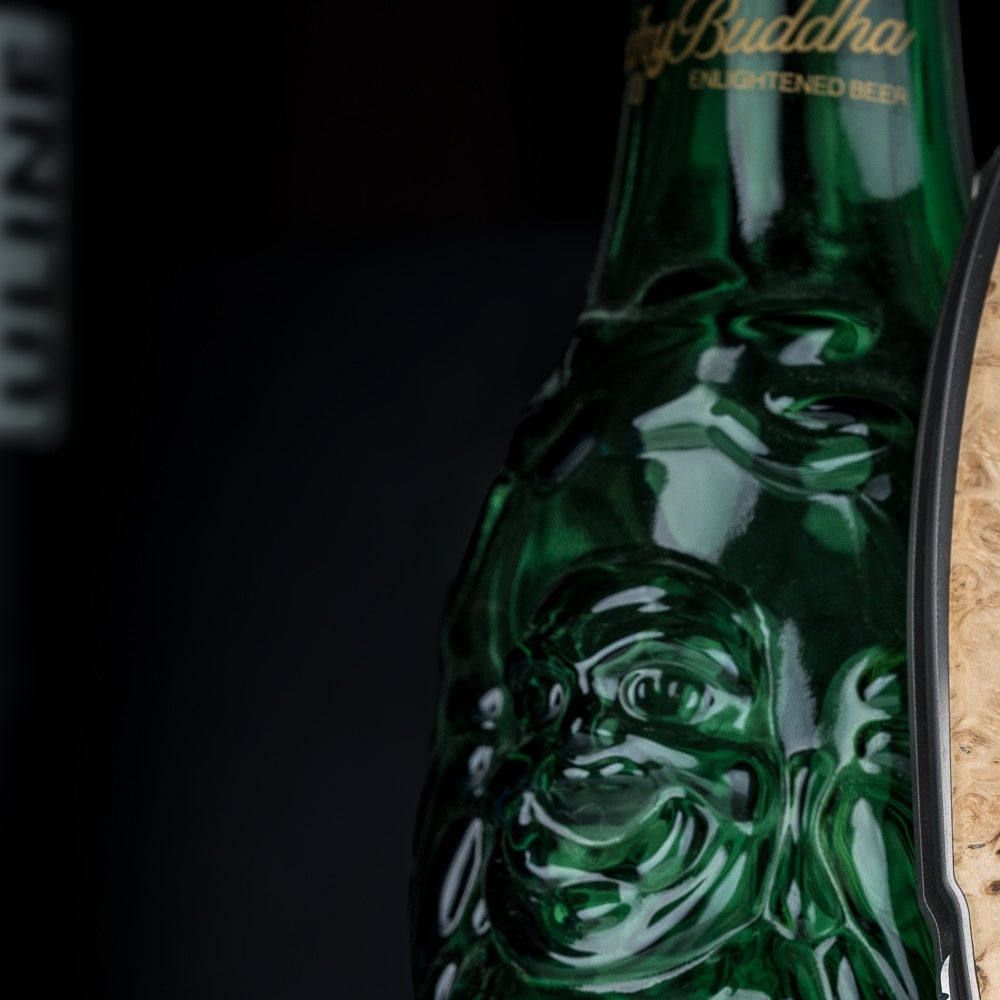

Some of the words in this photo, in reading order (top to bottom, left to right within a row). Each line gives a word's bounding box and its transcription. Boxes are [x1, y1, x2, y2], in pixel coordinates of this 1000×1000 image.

[667, 0, 916, 63] Buddha
[688, 68, 845, 98] ENLIGHTENED
[848, 78, 908, 106] BEER
